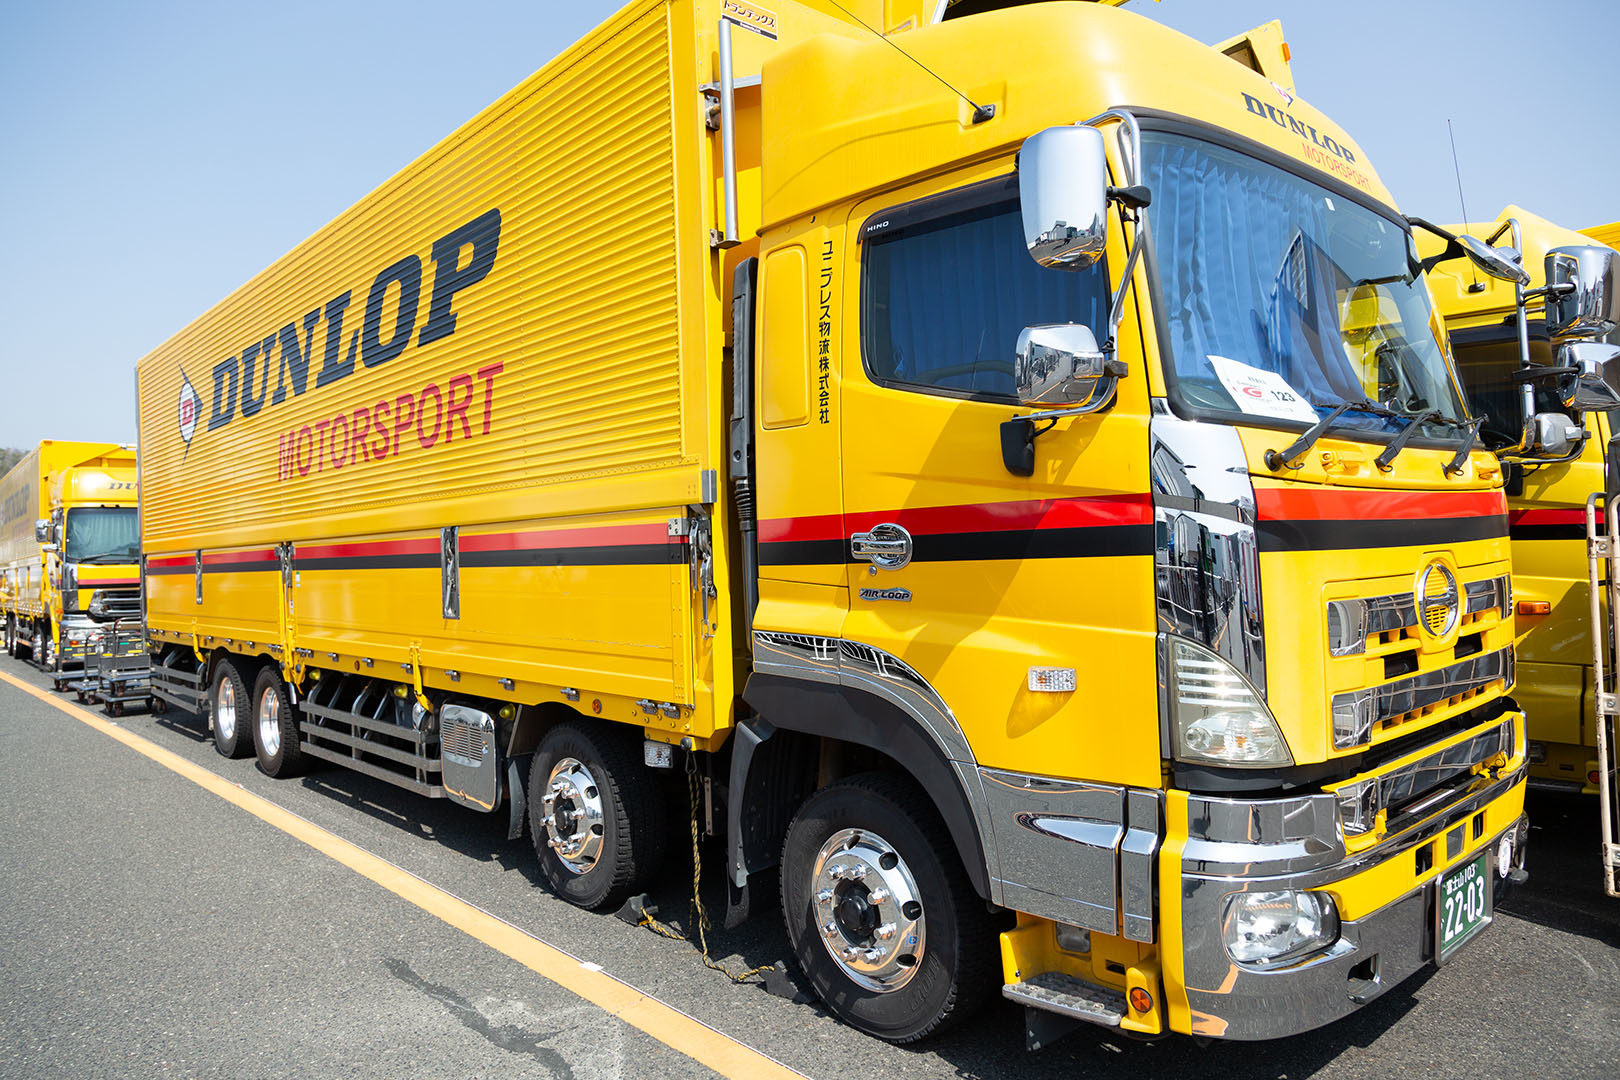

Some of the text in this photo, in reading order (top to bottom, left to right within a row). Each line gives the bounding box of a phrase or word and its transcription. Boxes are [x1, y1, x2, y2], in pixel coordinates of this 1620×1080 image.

[1240, 91, 1356, 165] DUNLOP
[1302, 142, 1372, 192] MOTORSPORT
[866, 220, 889, 232] HINO
[207, 207, 502, 432] DUNLOP
[818, 240, 833, 424] ユニプレス物流株式会社
[278, 360, 505, 482] MOTORSPORT
[1270, 390, 1296, 402] 123
[860, 590, 910, 600] AIR LOOP
[1445, 875, 1483, 942] 22-03
